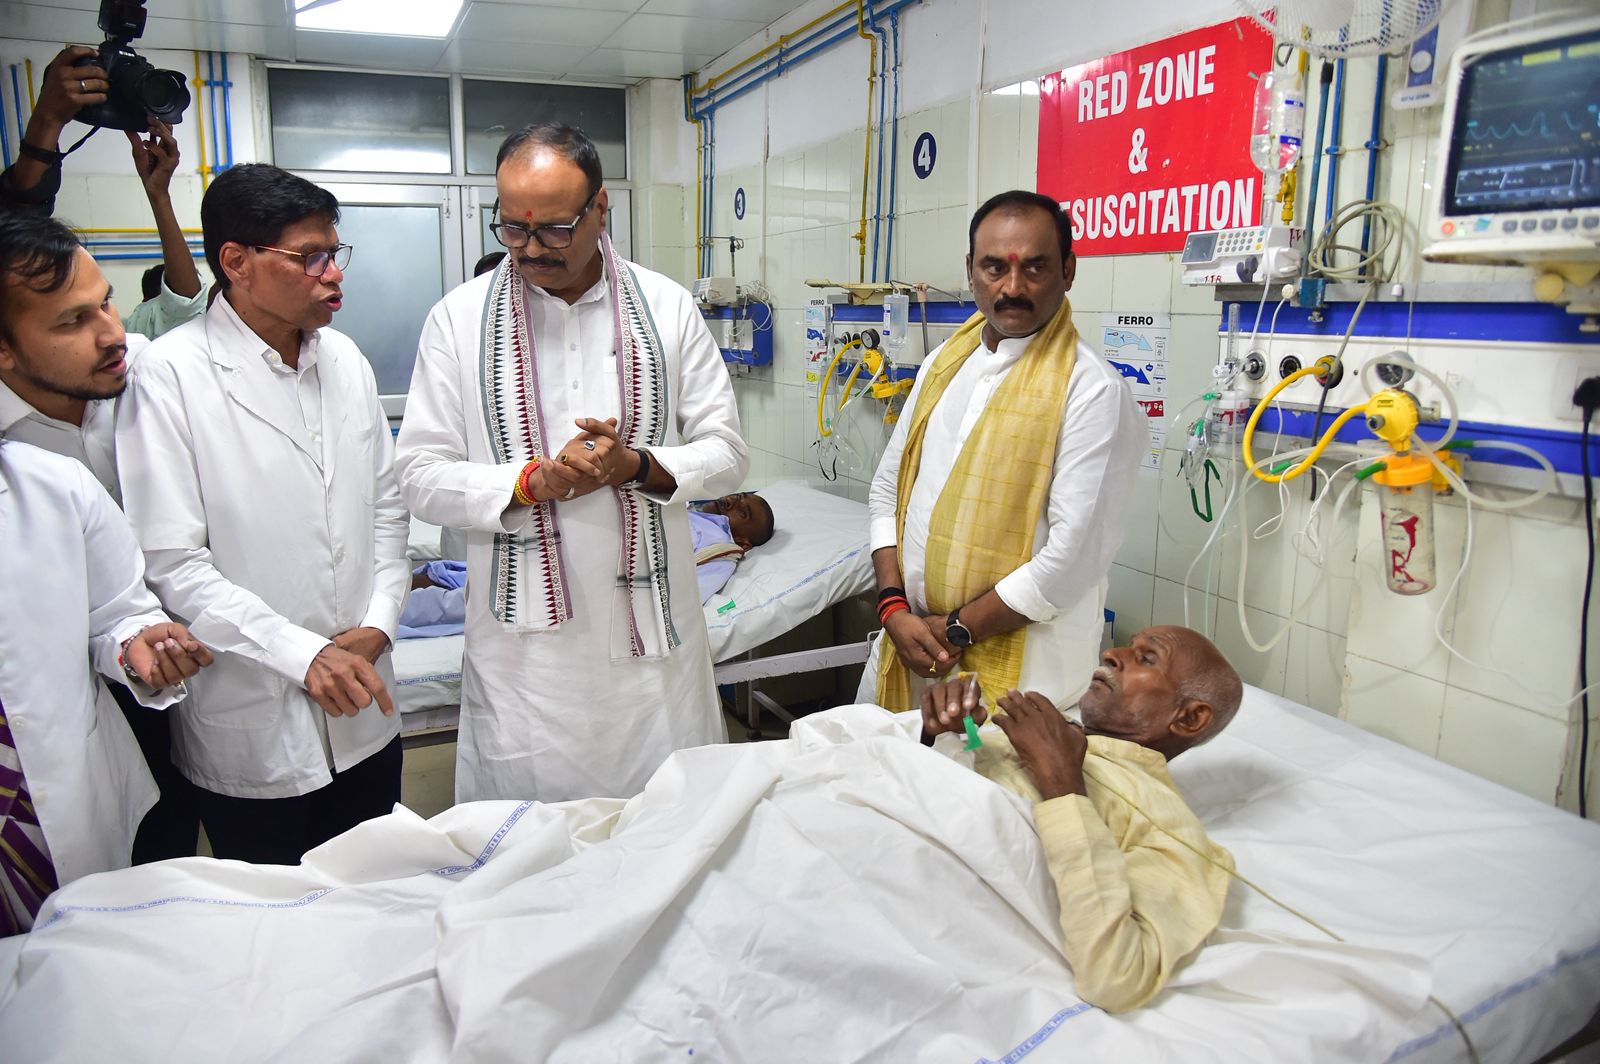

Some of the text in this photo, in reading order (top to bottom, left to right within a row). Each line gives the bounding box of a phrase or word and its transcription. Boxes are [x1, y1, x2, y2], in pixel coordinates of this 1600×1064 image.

[1078, 45, 1216, 123] RED ZONE
[917, 138, 931, 172] 4
[1128, 128, 1149, 174] &
[736, 193, 744, 216] 3
[1059, 178, 1254, 241] SUSCITATION
[1118, 316, 1154, 326] FERRO
[505, 805, 527, 829] HOSPITAL
[307, 891, 319, 902] 2025
